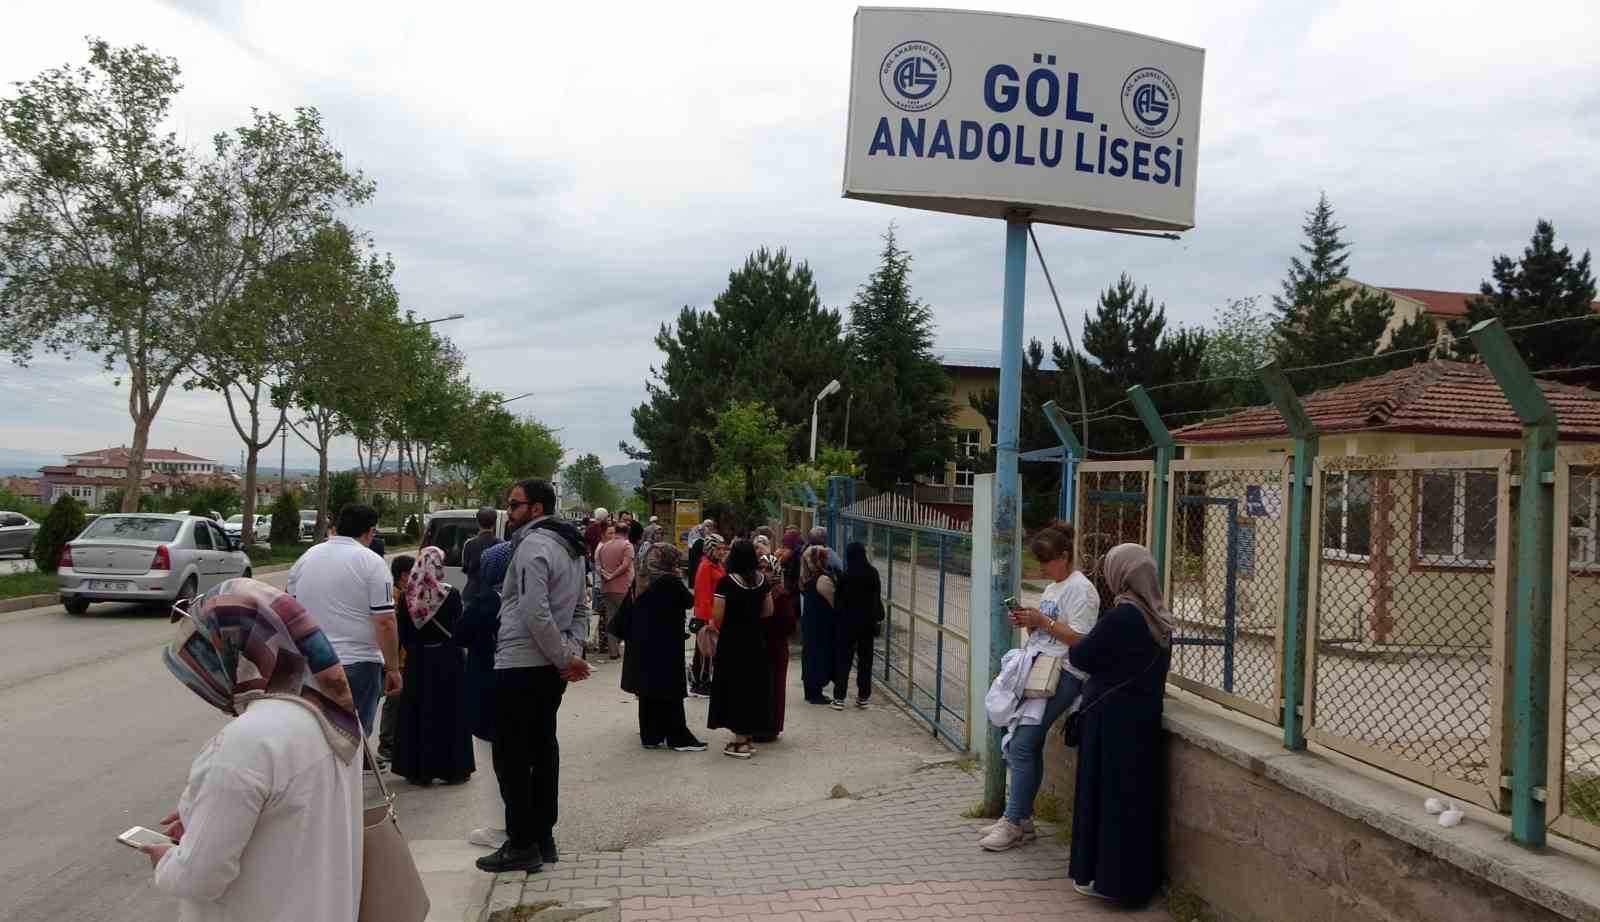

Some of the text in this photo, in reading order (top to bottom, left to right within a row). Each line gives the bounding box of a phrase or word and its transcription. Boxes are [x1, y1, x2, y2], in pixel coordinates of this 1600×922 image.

[983, 53, 1094, 123] GÖL
[868, 116, 1184, 188] ANADOLU LİSESİ
